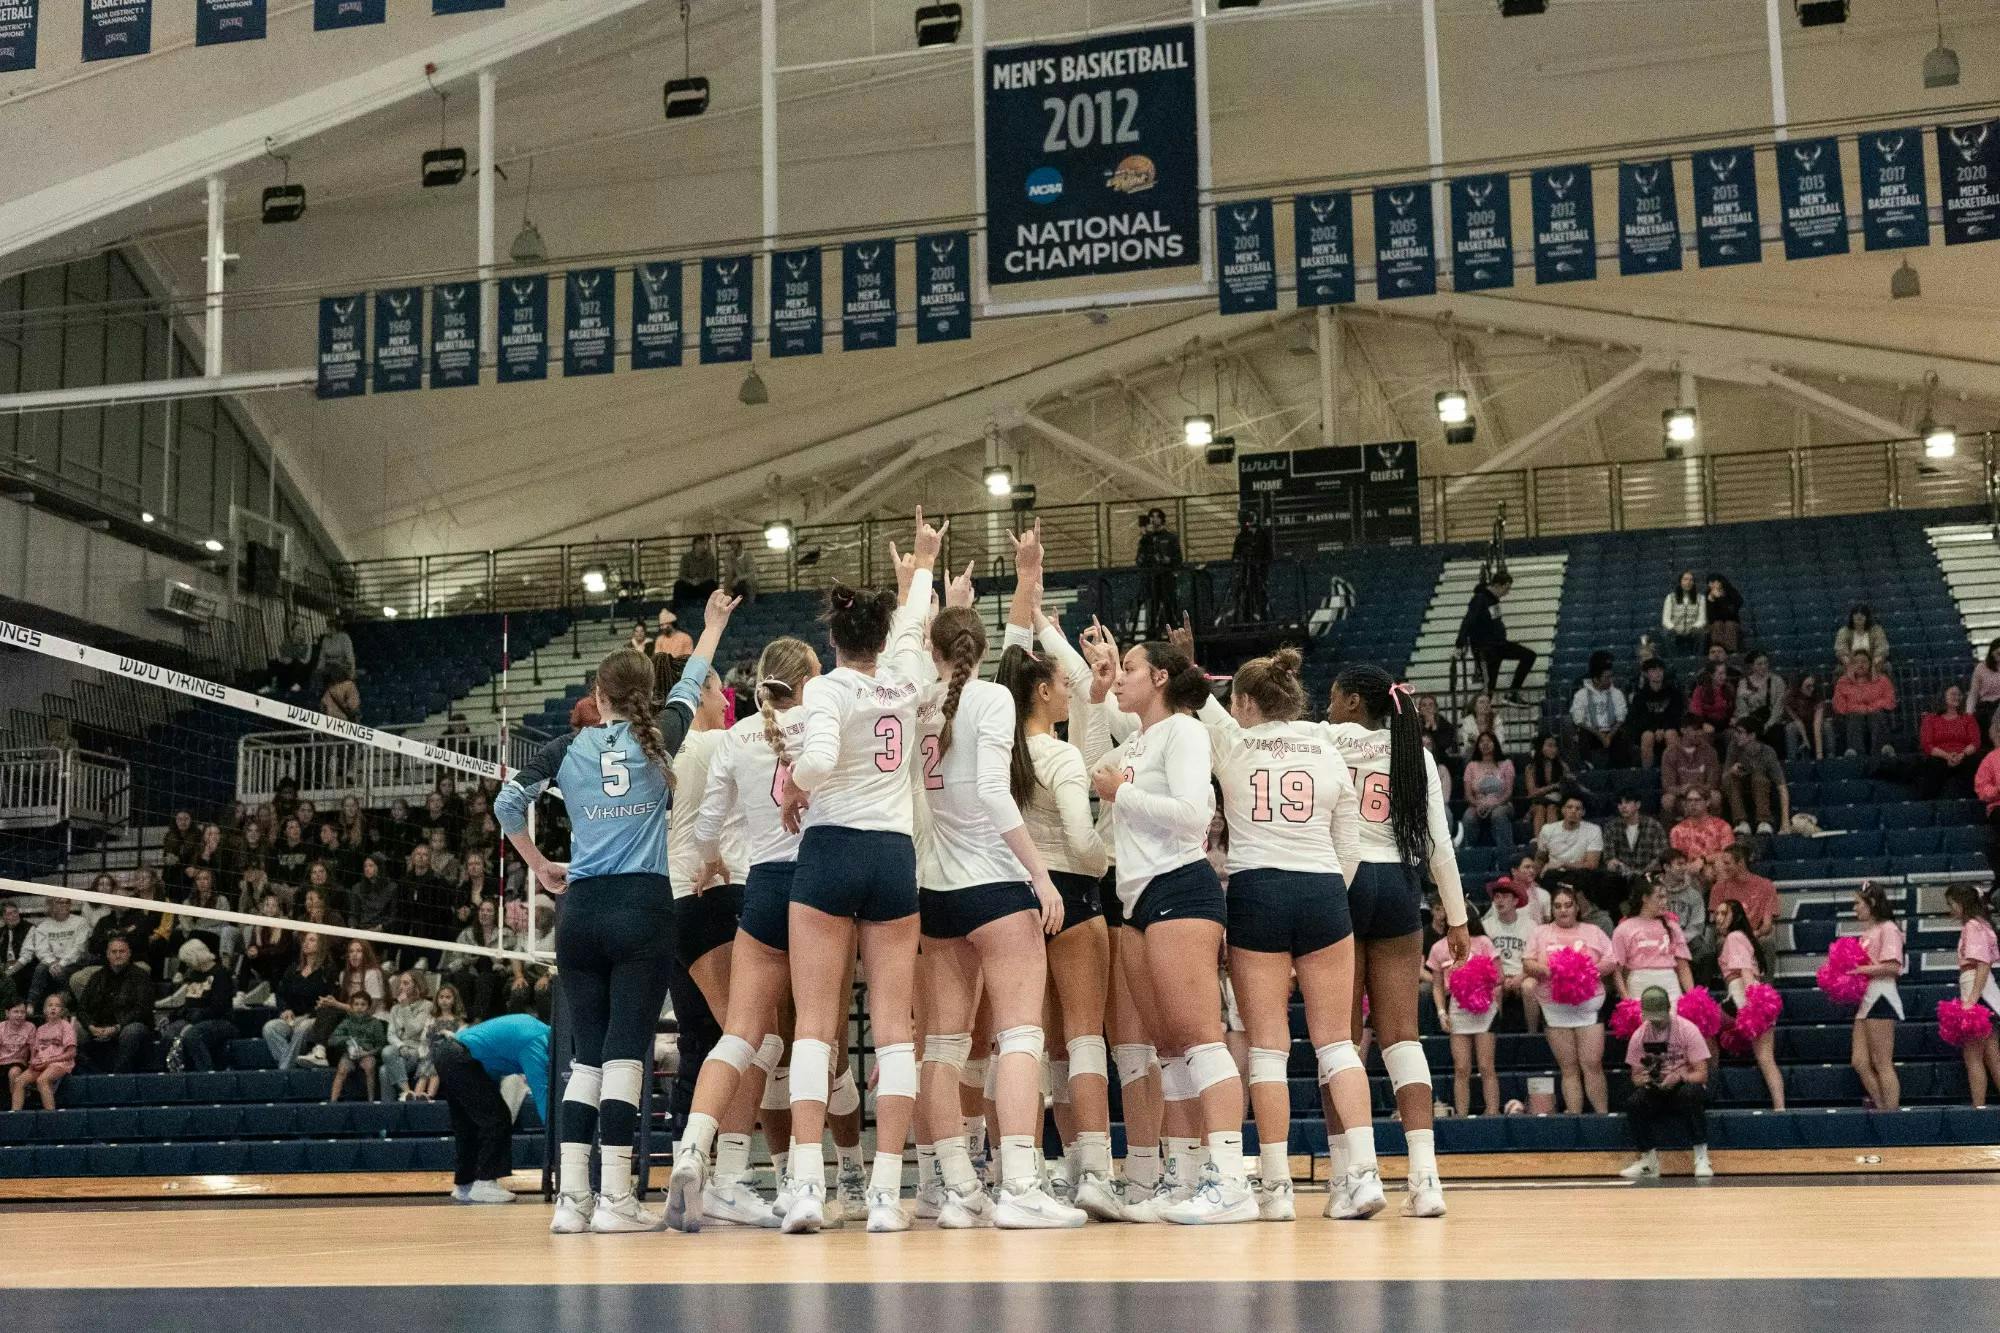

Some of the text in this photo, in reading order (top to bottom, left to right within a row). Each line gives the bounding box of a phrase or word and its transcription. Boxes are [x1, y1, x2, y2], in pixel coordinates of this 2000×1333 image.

[91, 0, 147, 10] BASKET
[0, 6, 32, 20] ETBALL
[109, 8, 139, 17] DISTRICT
[98, 15, 138, 27] CHAMPIONS
[0, 30, 24, 38] MPIONS
[993, 42, 1188, 90] MEN'S BASKETBALL
[1043, 88, 1140, 153] 2012
[1880, 166, 1905, 182] 2017
[1957, 165, 1986, 181] 2020
[1880, 184, 1907, 196] MEN'S
[1960, 184, 1987, 196] MEN'S
[1800, 192, 1826, 206] MEN'S
[1868, 194, 1921, 210] BASKETBALL
[1948, 194, 2000, 210] BASKETBALL
[1713, 202, 1740, 214] MEN'S
[1788, 202, 1841, 218] BASKETBALL
[1551, 219, 1577, 232] MEN'S
[1637, 212, 1662, 225] MEN'S
[1702, 212, 1753, 228] BASKETBALL
[1017, 210, 1171, 247] NATIONAL
[1469, 228, 1494, 240] MEN'S
[1626, 222, 1674, 236] BASKETBALL
[1235, 235, 1260, 250] 2001
[1392, 236, 1416, 248] MEN'S
[1539, 230, 1589, 244] BASKETBALL
[1312, 244, 1336, 255] MEN'S
[1458, 238, 1506, 252] BASKETBALL
[1004, 234, 1184, 274] CHAMPIONS
[1236, 252, 1260, 263] MEN'S
[1380, 246, 1428, 261] BASKETBALL
[1301, 254, 1348, 268] BASKETBALL
[931, 266, 955, 280] 2001
[1224, 262, 1272, 276] BASKETBALL
[858, 289, 880, 300] MEN'S
[932, 282, 954, 293] MEN'S
[786, 298, 808, 308] MEN'S
[848, 299, 890, 312] BASKETBALL
[921, 292, 966, 306] BASKETBALL
[716, 304, 738, 314] MEN'S
[775, 306, 817, 320] BASKETBALL
[580, 318, 602, 328] MEN'S
[648, 312, 670, 322] MEN'S
[706, 314, 748, 327] BASKETBALL
[512, 324, 534, 334] MEN'S
[568, 328, 610, 340] BASKETBALL
[637, 321, 678, 334] BASKETBALL
[502, 332, 542, 346] BASKETBALL
[1370, 469, 1405, 482] GUEST
[1252, 479, 1282, 491] HOME
[0, 622, 42, 648] INGS
[119, 657, 226, 700] WWU VIKINGS
[286, 705, 374, 741] WWU VIKINGS
[874, 714, 903, 772] 3
[424, 744, 496, 775] WWU VIKINGS
[920, 734, 944, 790] 2
[600, 750, 632, 798] 5
[1250, 769, 1314, 824] 19
[1347, 766, 1392, 824] 6
[582, 800, 658, 820] VIKINGS
[1493, 936, 1527, 952] ESTER
